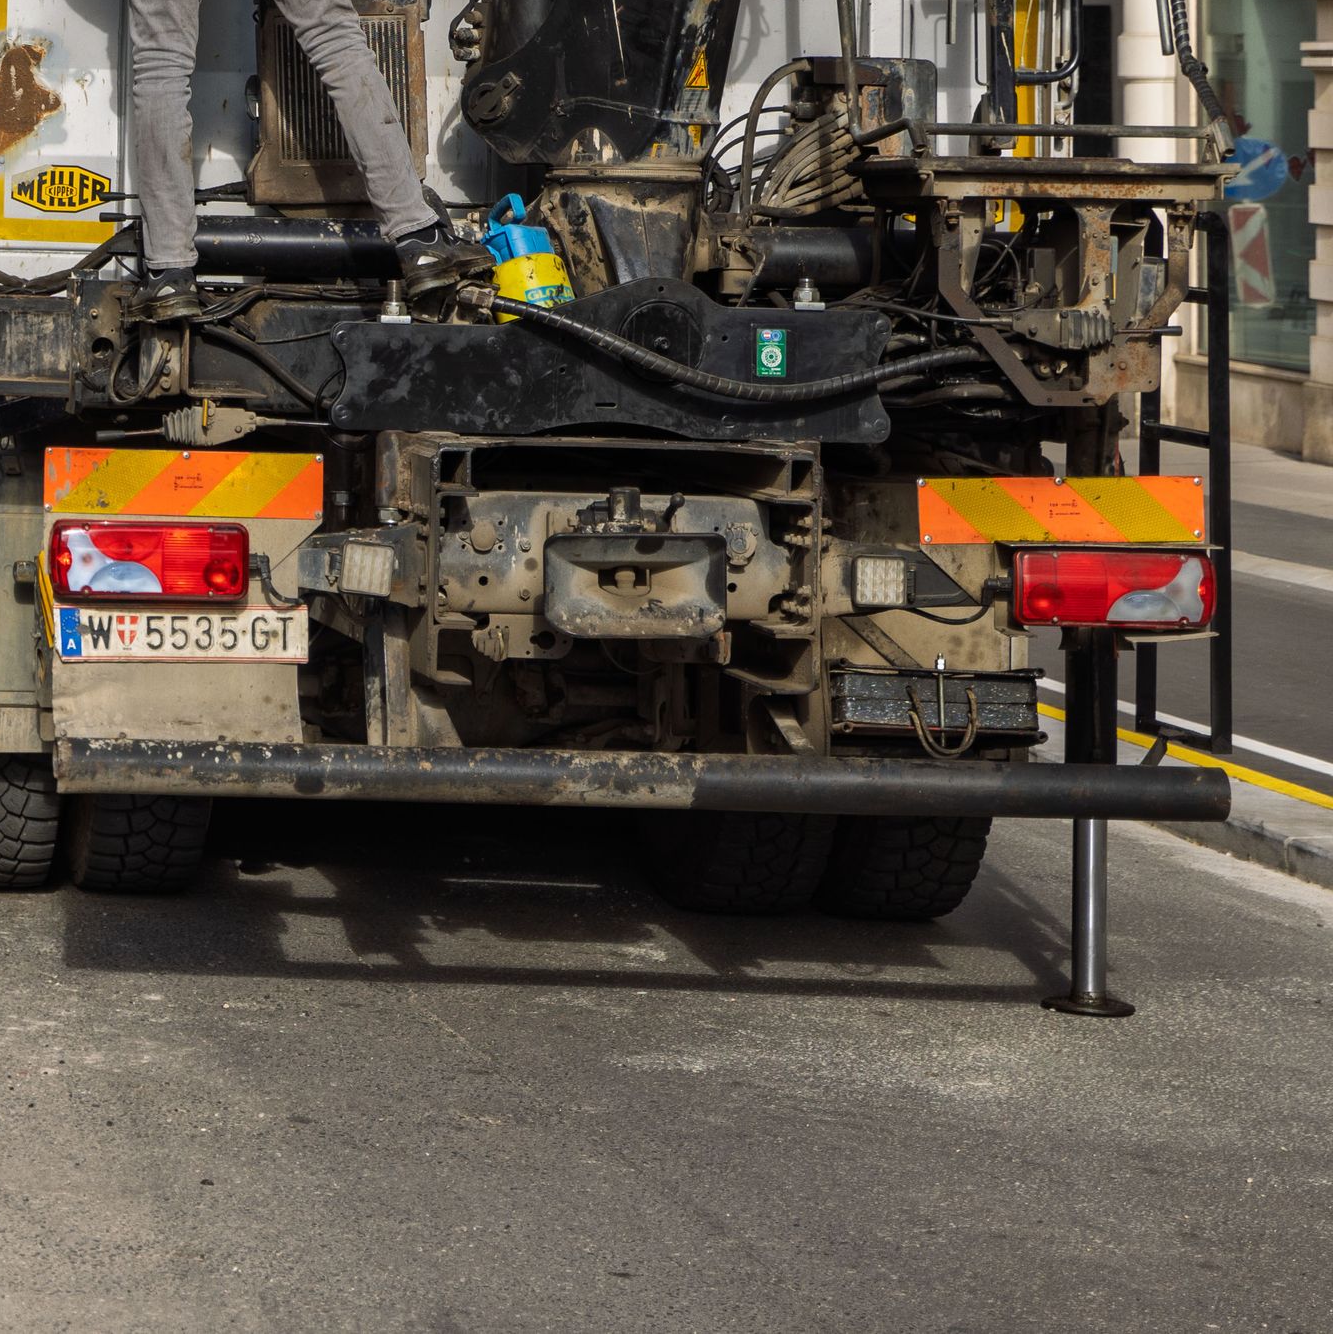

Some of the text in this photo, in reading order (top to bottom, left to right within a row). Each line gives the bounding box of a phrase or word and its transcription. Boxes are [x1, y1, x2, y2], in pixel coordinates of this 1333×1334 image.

[17, 169, 109, 208] MEILLER
[48, 186, 75, 198] KIPPER
[66, 638, 77, 650] A
[88, 616, 111, 650] W
